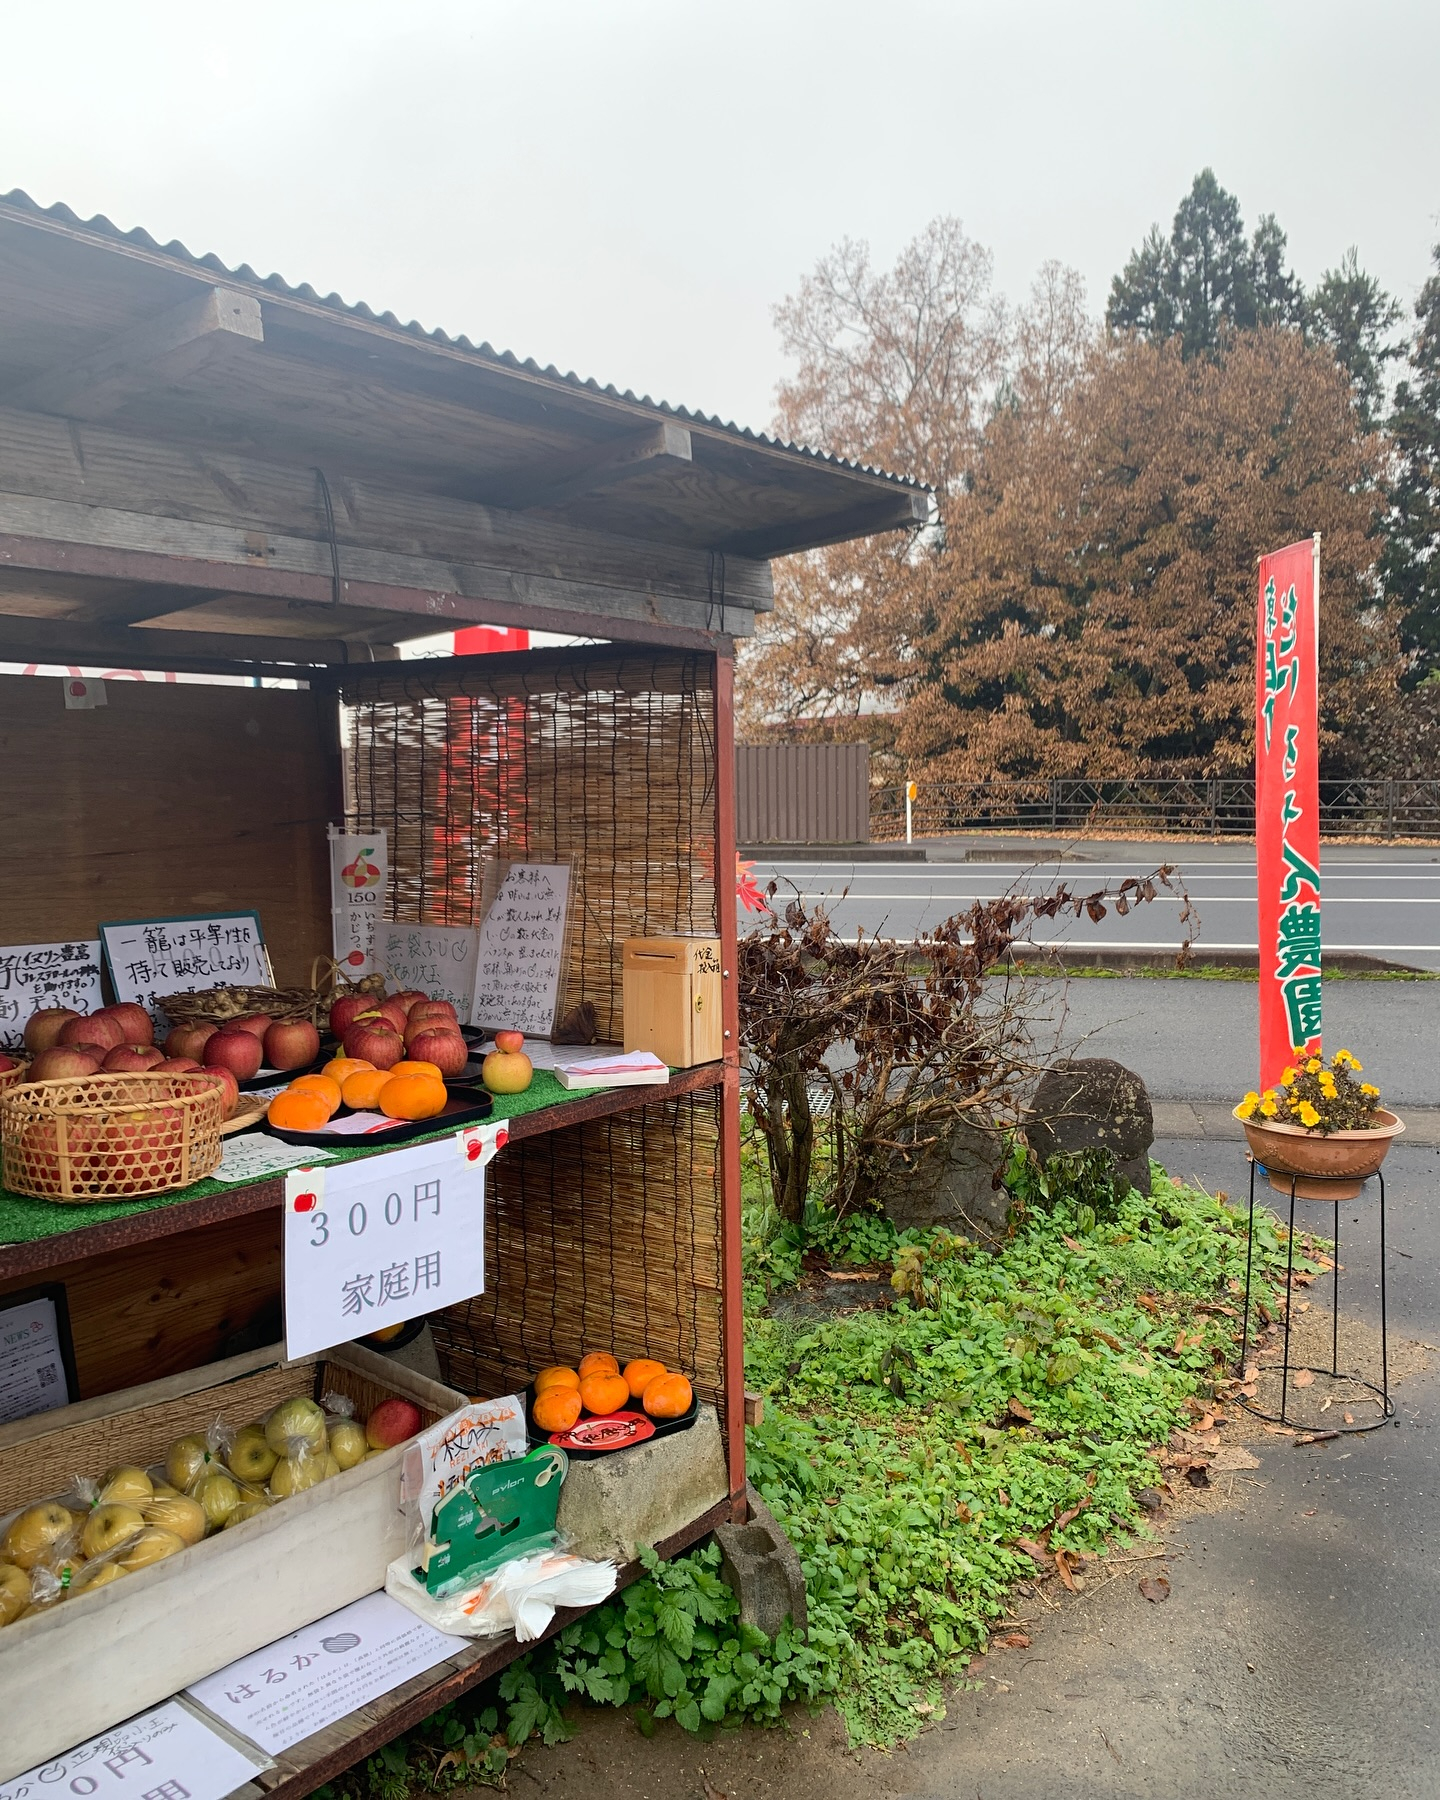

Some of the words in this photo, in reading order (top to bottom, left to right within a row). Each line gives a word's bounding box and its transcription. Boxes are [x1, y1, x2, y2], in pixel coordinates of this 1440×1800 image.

[347, 891, 376, 903] 150
[693, 947, 713, 961] 代金
[310, 1178, 441, 1247] 300円
[341, 1250, 441, 1317] 家庭用
[3, 1329, 30, 1346] NEWS
[492, 1477, 525, 1495] pylon
[224, 1651, 320, 1703] はるか
